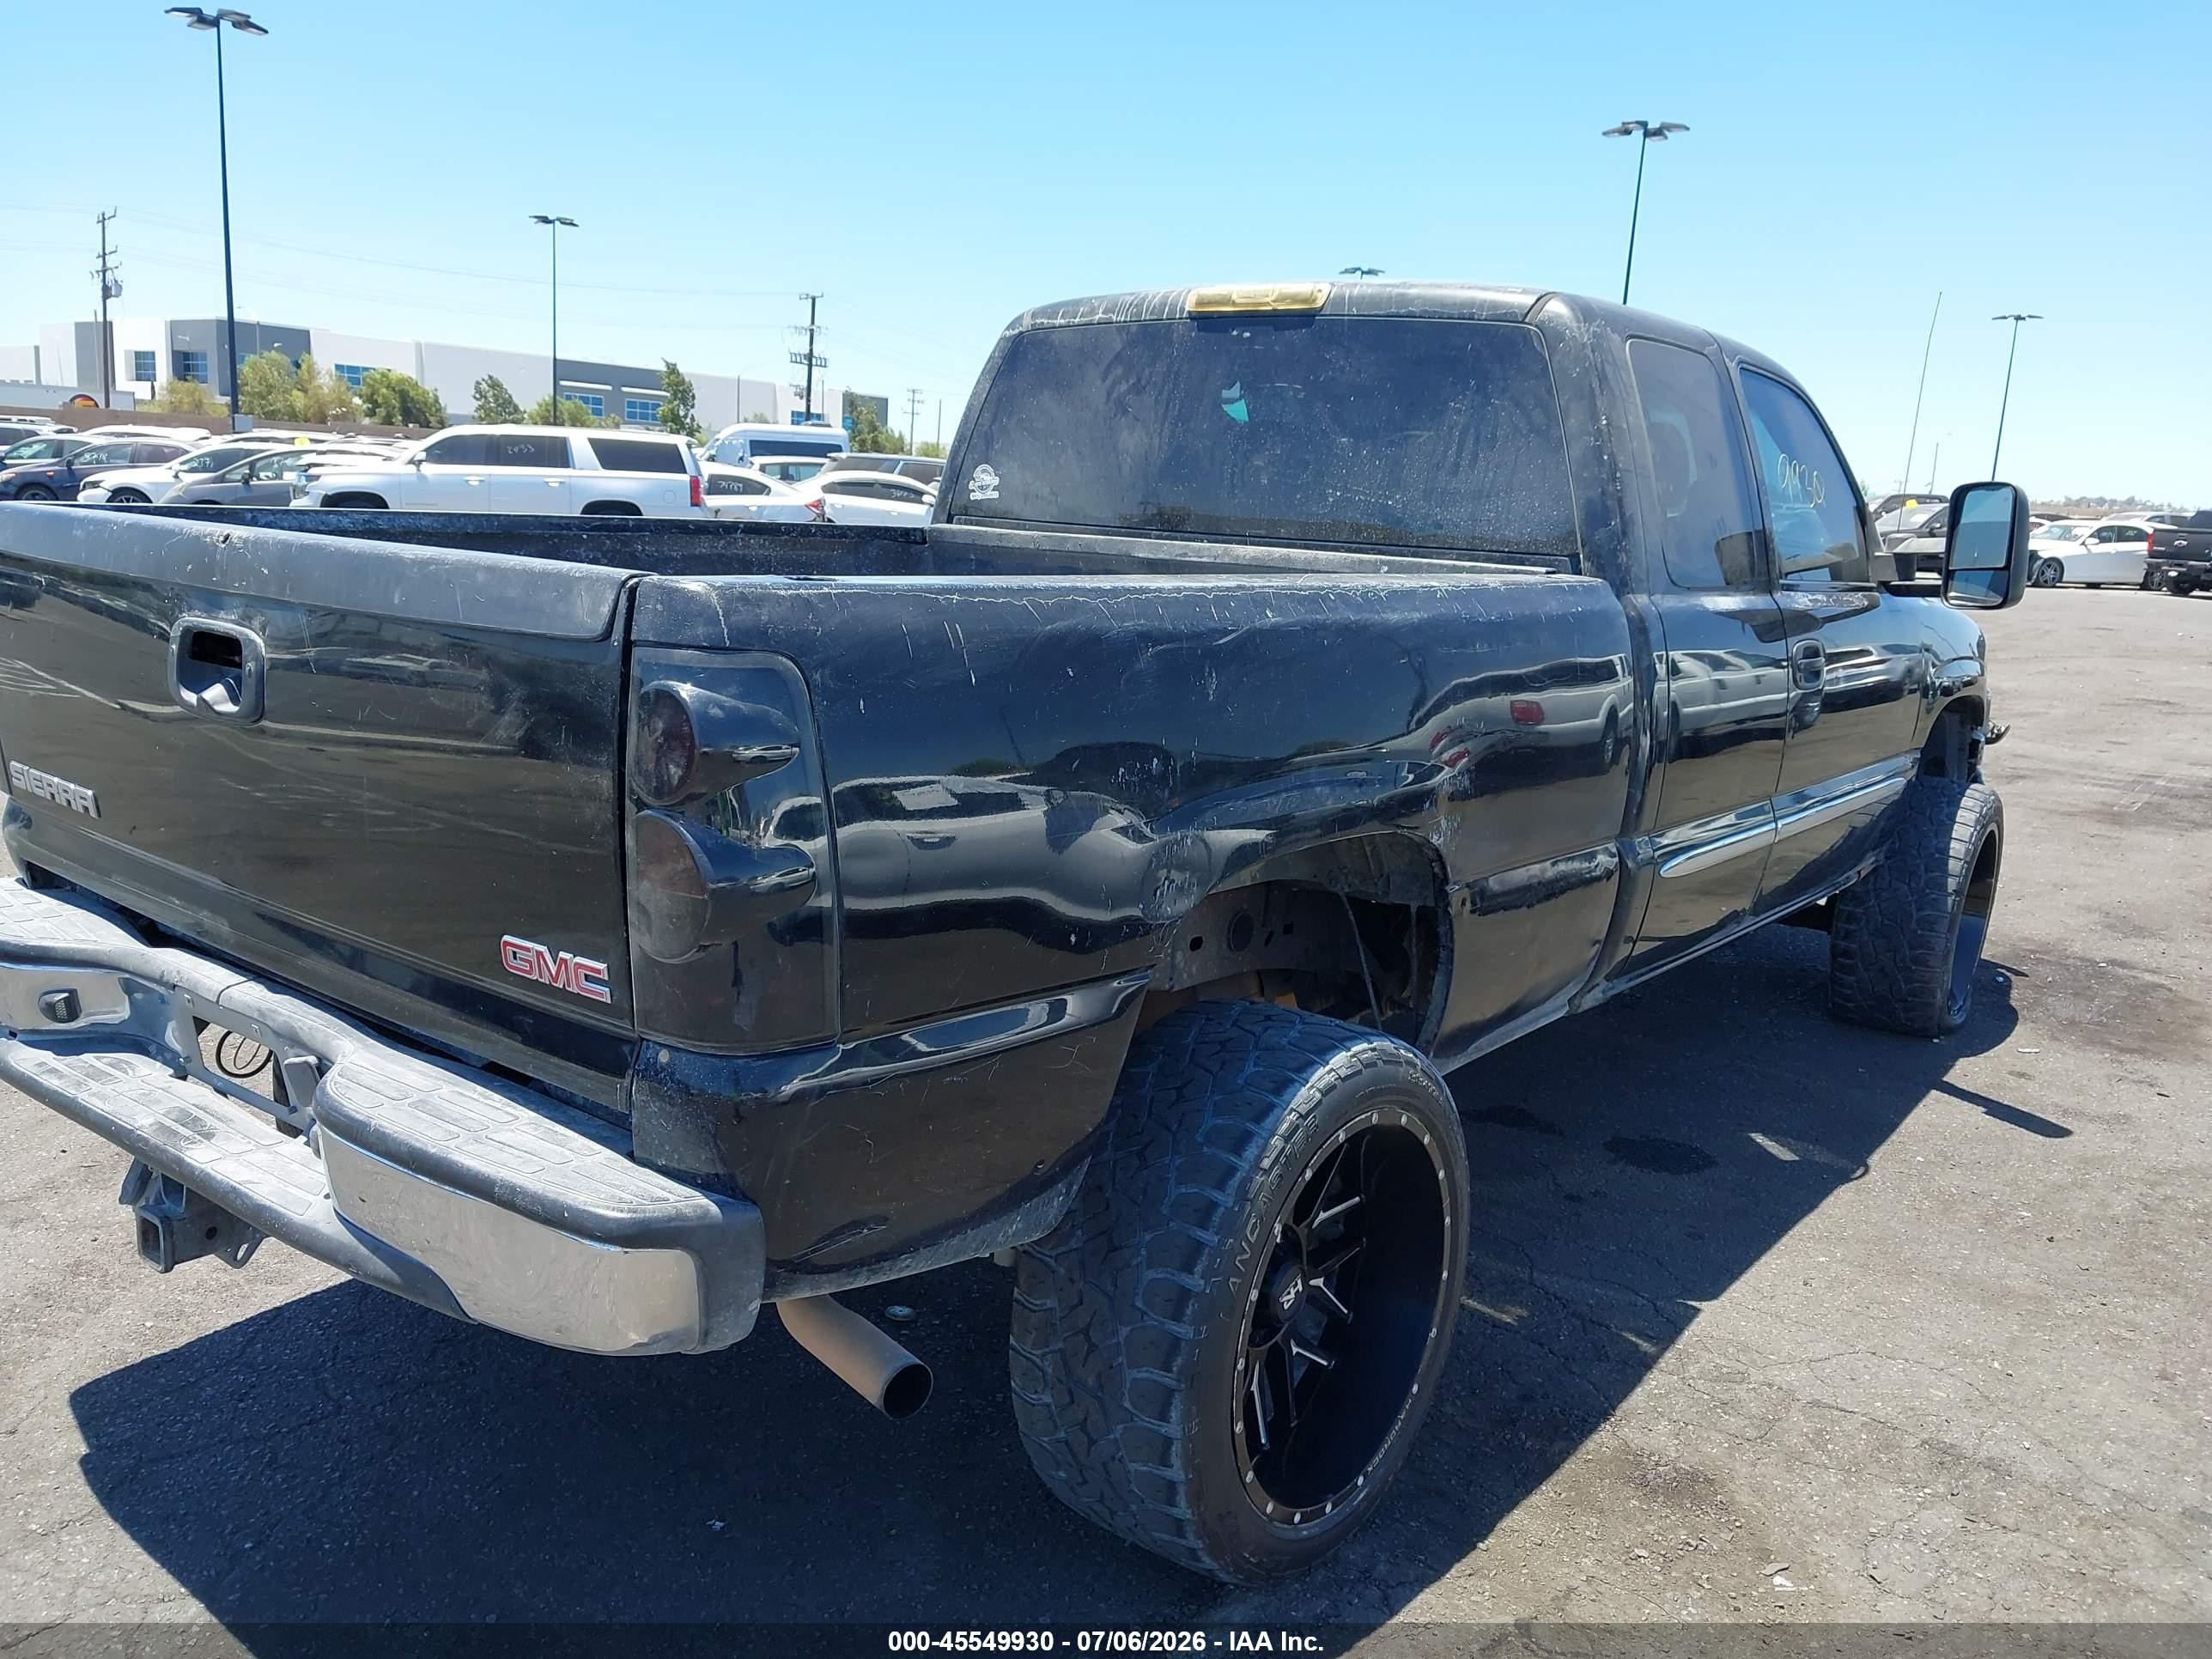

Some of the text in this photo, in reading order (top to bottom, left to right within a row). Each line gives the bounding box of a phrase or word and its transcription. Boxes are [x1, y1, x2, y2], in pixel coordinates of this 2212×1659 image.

[1778, 453, 1826, 508] 9930
[9, 760, 101, 818] SIERRA
[501, 934, 612, 1005] GMC
